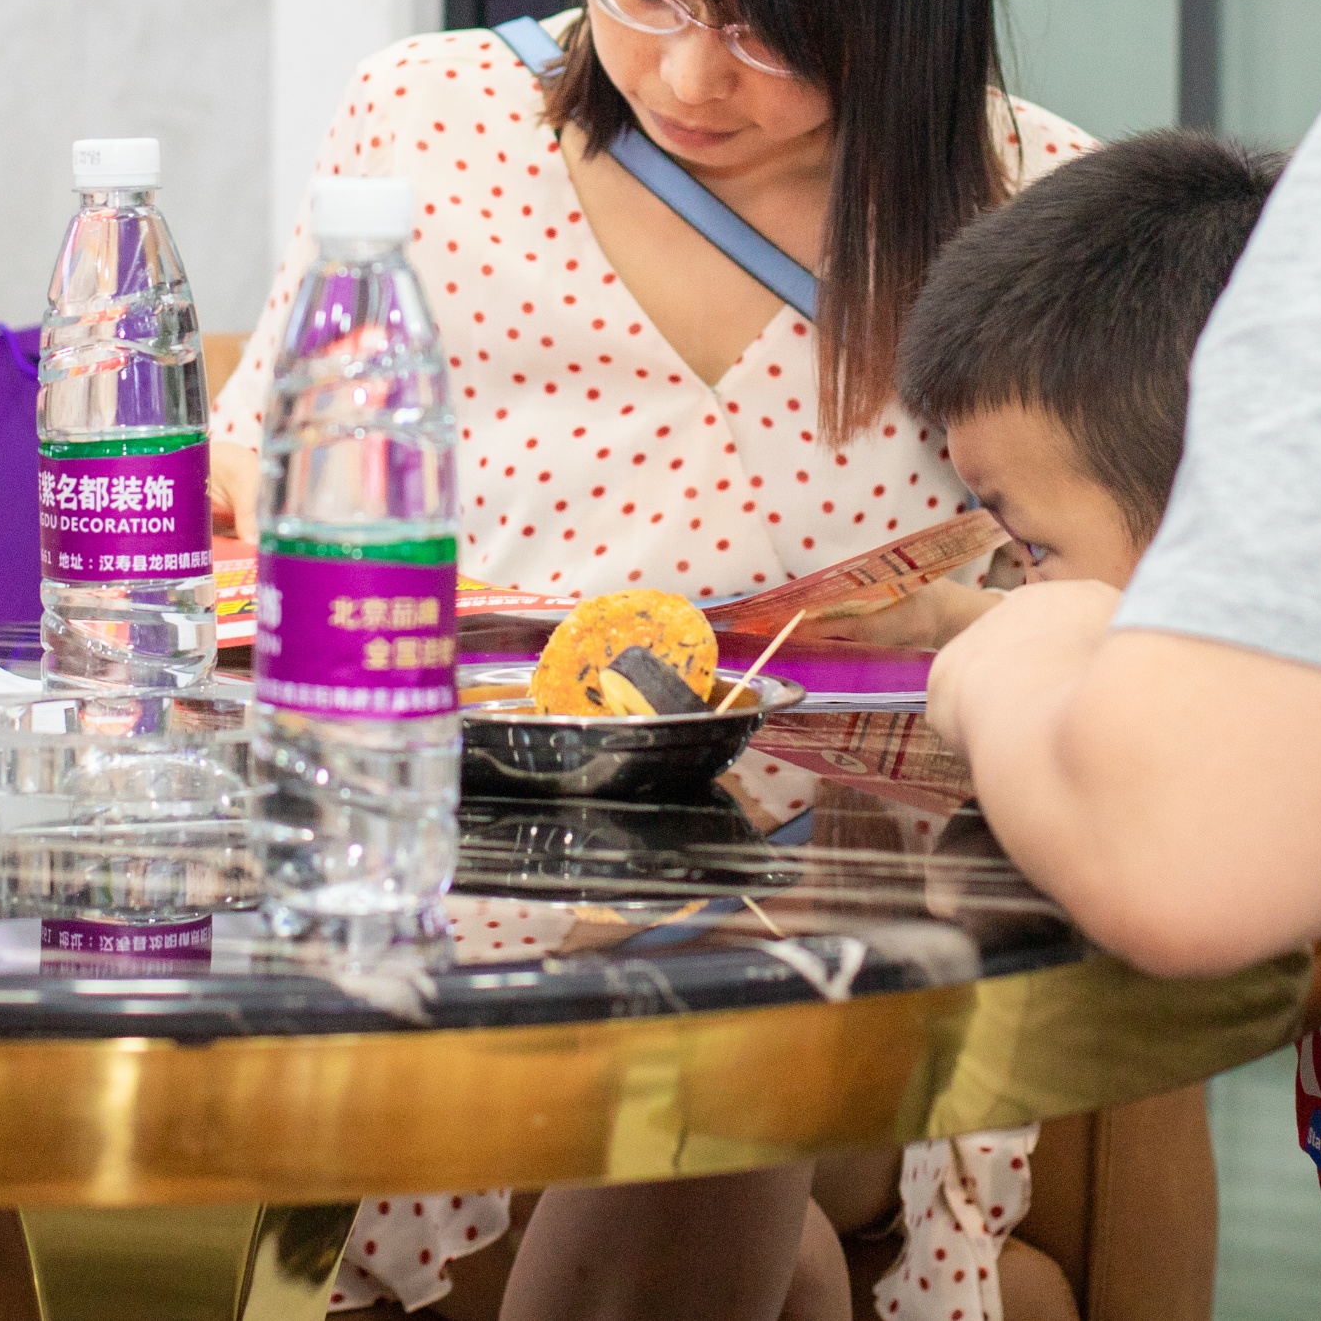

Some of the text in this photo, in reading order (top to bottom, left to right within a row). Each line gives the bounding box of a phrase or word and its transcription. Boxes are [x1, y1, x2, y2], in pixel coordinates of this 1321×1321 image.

[39, 470, 175, 512] 紫名都装饰
[60, 516, 175, 533] DECORATION
[59, 550, 213, 572] 地址：汉寿县龙阳镇辰阳
